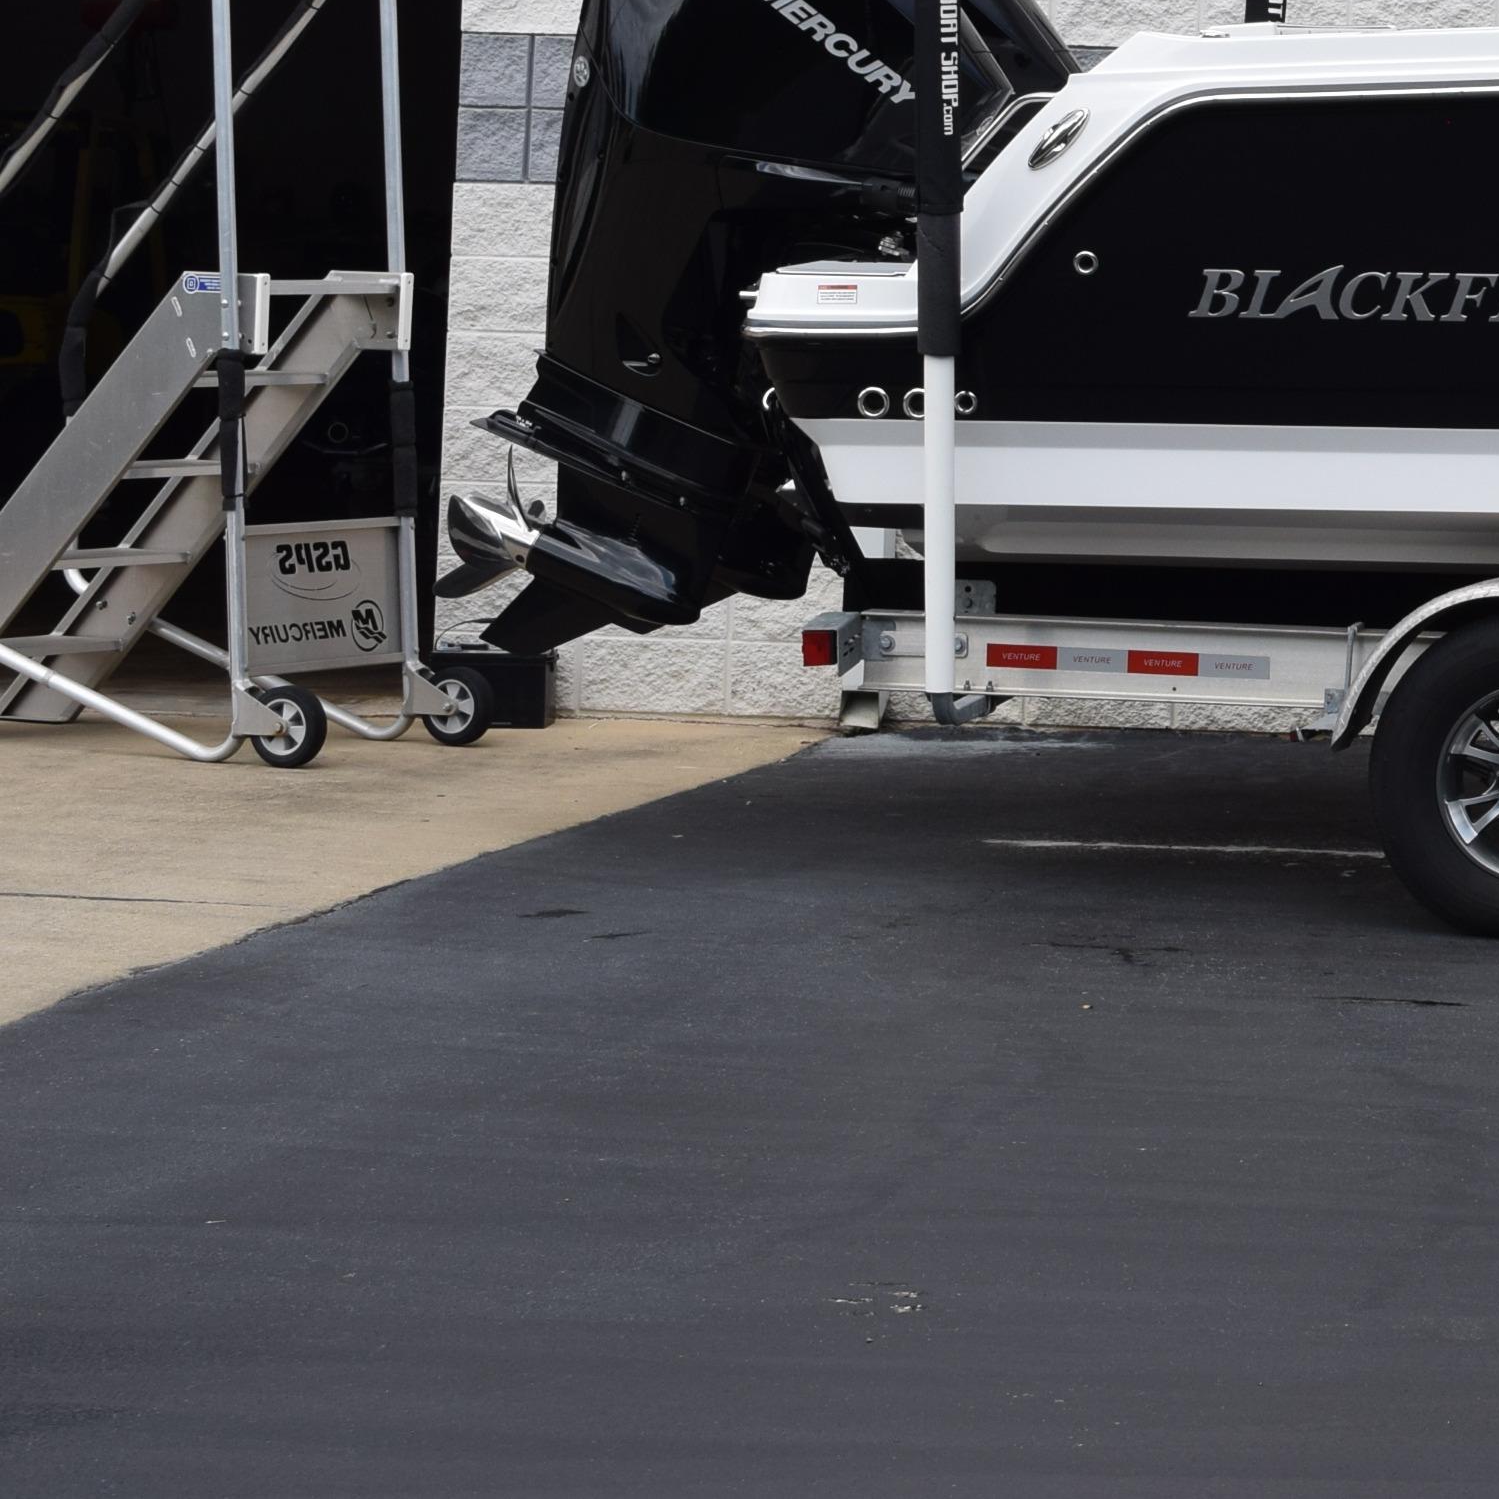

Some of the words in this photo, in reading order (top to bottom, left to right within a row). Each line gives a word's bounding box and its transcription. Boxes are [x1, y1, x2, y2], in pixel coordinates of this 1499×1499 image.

[1002, 652, 1041, 661] VENTURE
[1072, 655, 1112, 664] VENTURE
[1143, 658, 1183, 668] VENTURE
[1214, 662, 1254, 671] VENTURE
